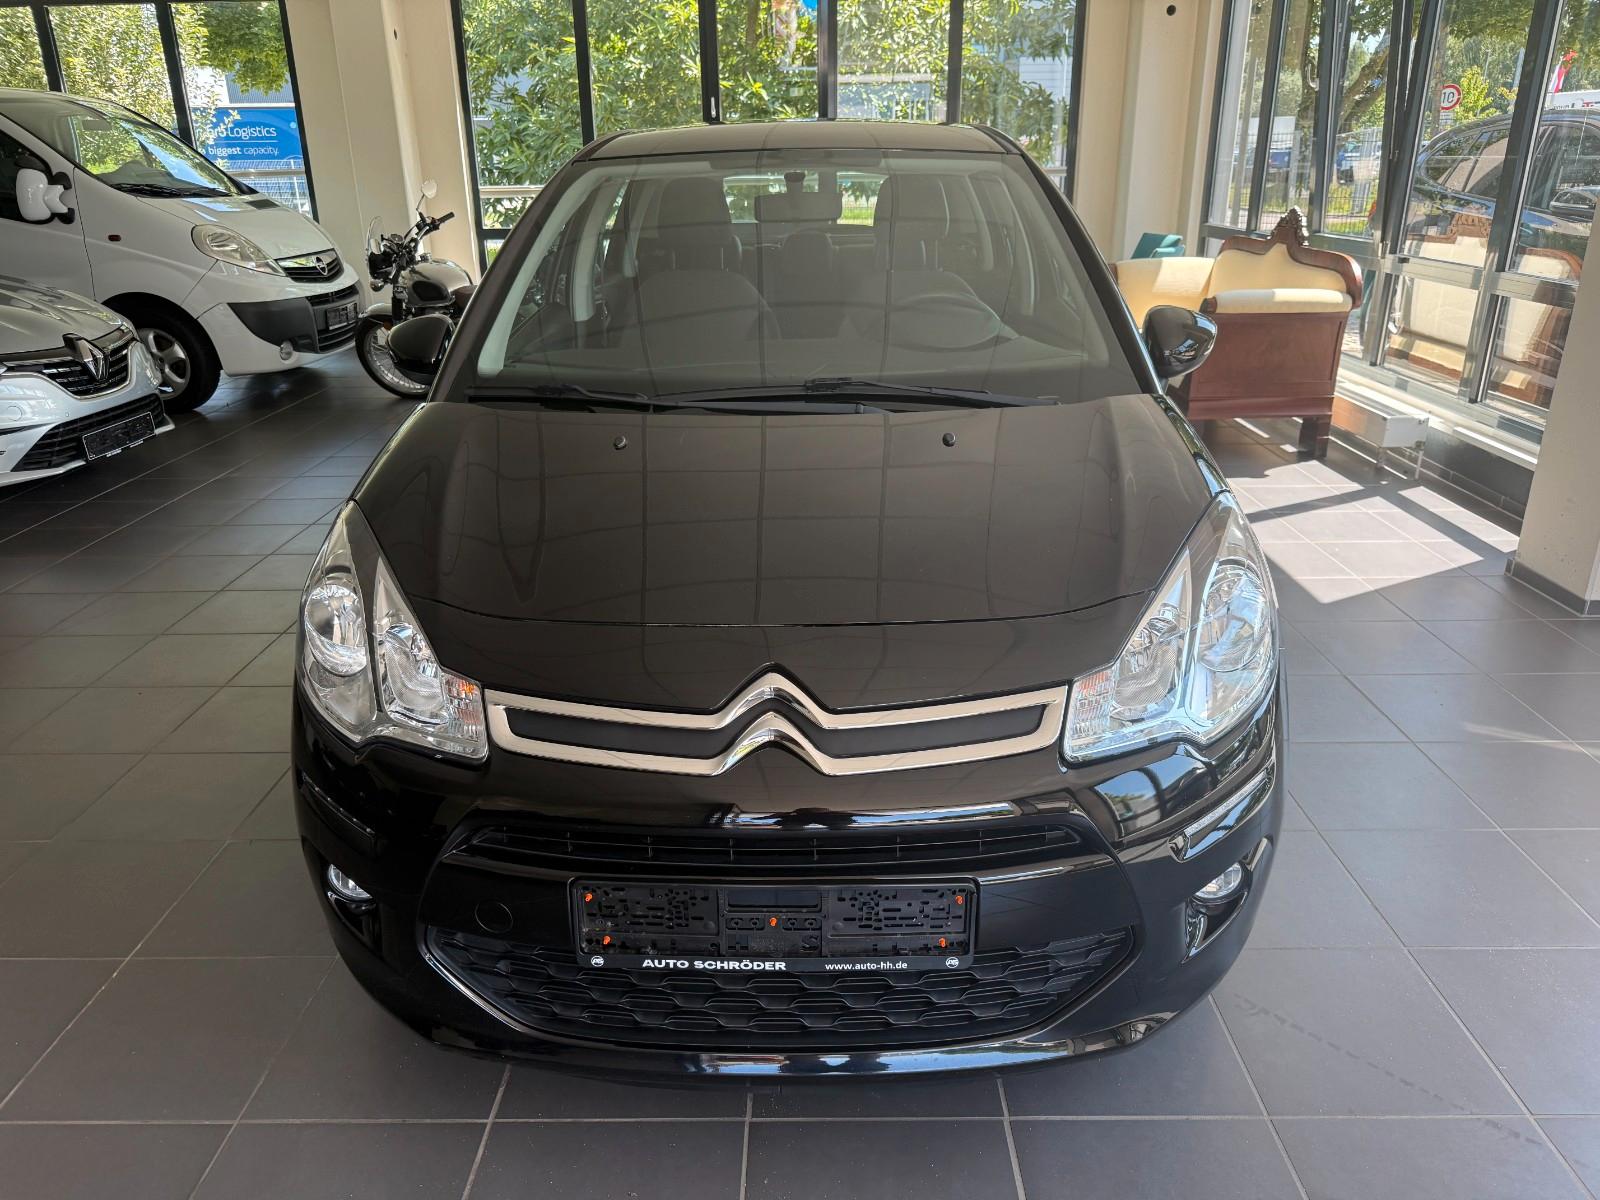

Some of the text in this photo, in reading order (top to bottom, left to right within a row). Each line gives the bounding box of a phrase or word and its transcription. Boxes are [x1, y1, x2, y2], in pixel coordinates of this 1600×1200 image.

[1442, 91, 1455, 104] 10
[228, 125, 278, 140] Logistics
[208, 146, 242, 157] biggest
[642, 958, 788, 971] AUTO SCHRÖDER
[824, 960, 909, 971] www.auto-hh.de
